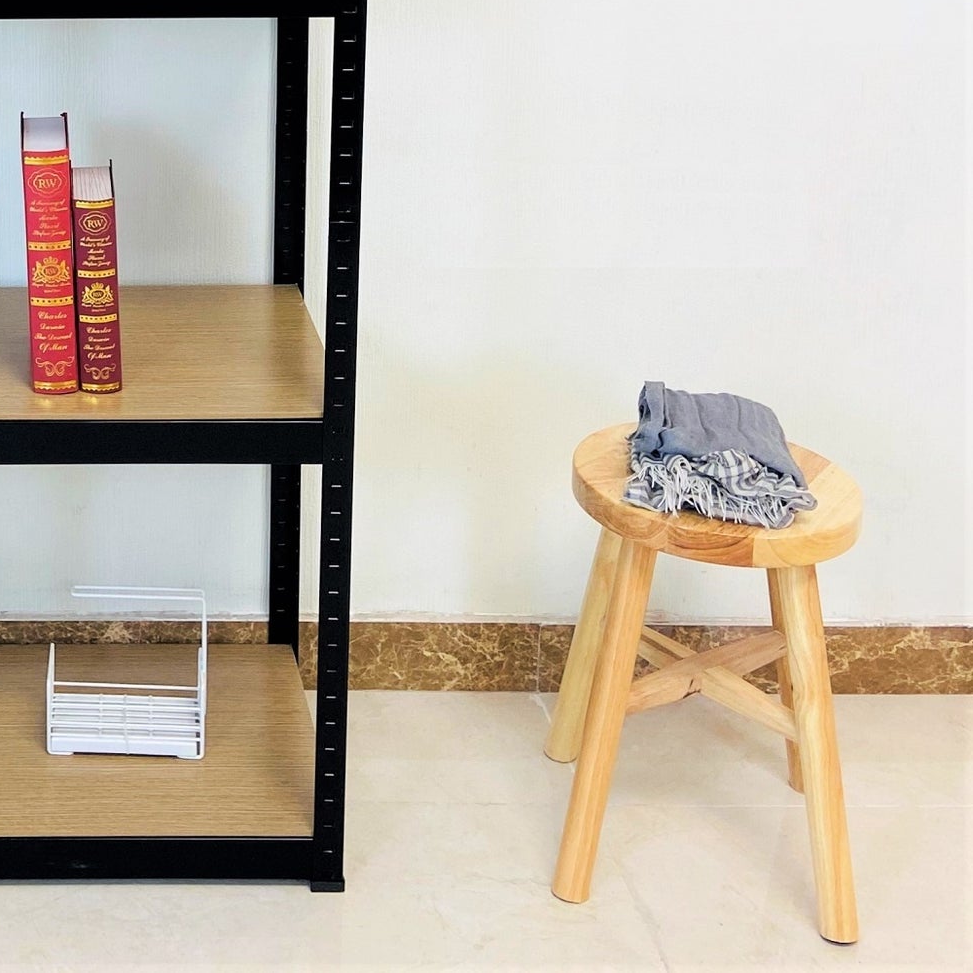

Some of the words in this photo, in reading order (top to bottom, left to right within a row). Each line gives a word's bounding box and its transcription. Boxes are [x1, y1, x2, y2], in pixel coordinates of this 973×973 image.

[38, 178, 57, 188] RW
[87, 219, 103, 228] RW
[38, 311, 67, 320] Charles
